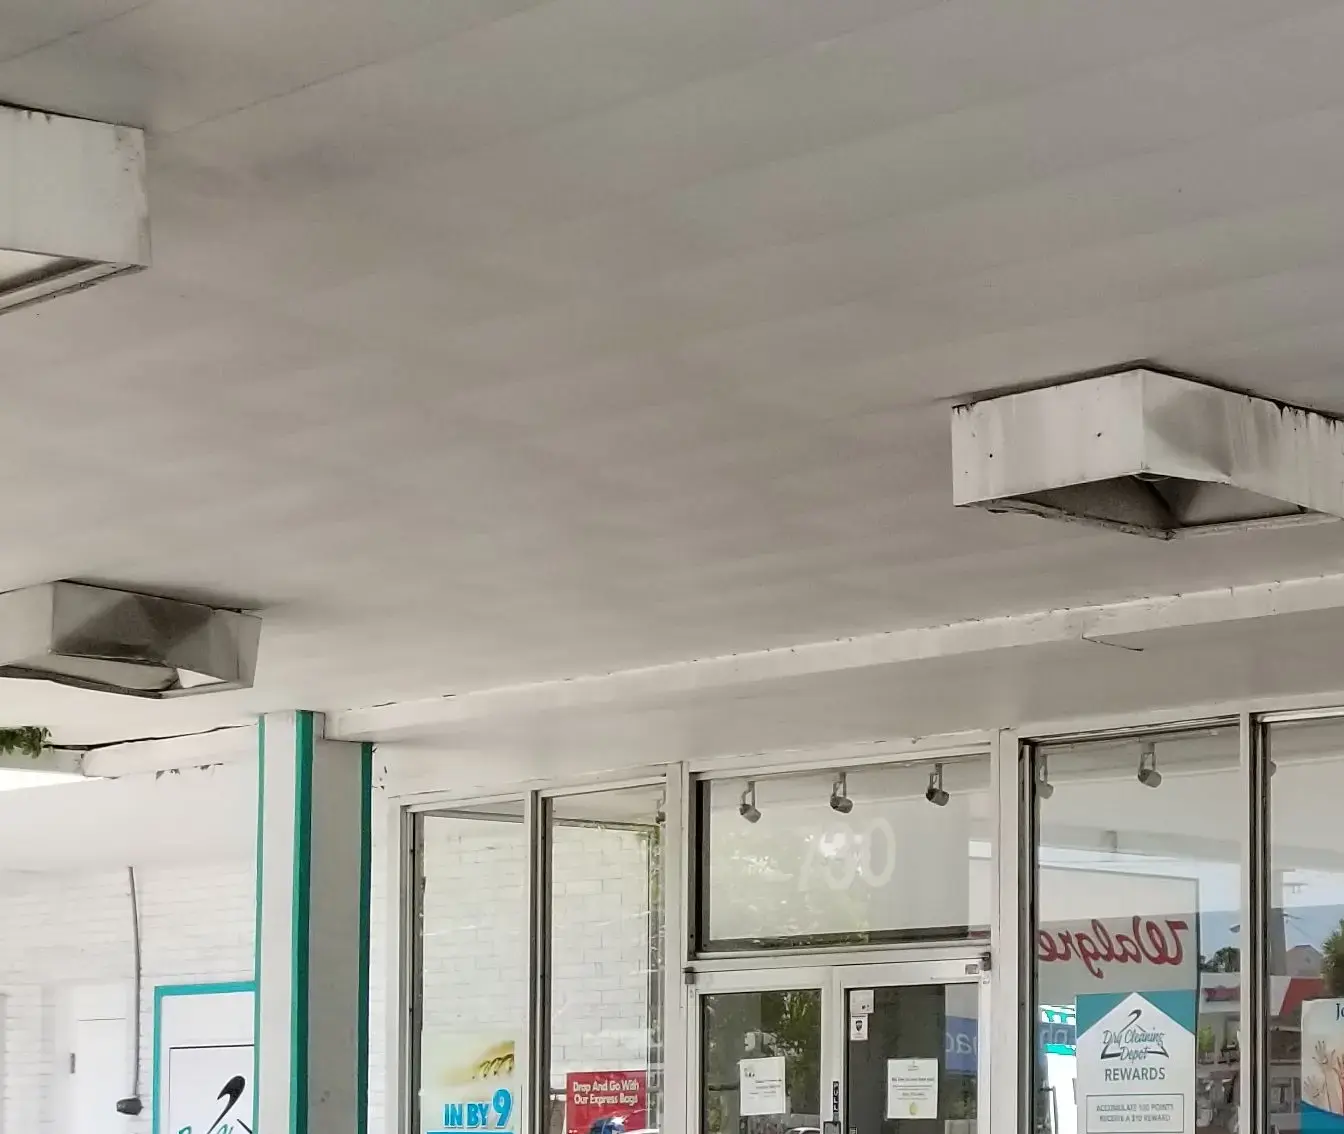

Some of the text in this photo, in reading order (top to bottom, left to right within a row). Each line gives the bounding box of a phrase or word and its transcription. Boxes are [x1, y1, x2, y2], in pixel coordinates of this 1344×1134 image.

[1102, 1026, 1166, 1047] Dry Cleaning
[1120, 1044, 1150, 1063] Depot
[1104, 1067, 1166, 1082] REWARDS
[592, 1080, 608, 1091] And
[609, 1080, 621, 1091] Go
[621, 1079, 640, 1091] With
[444, 1087, 513, 1128] IN BY 9
[574, 1093, 588, 1104] Our
[590, 1093, 618, 1107] Express
